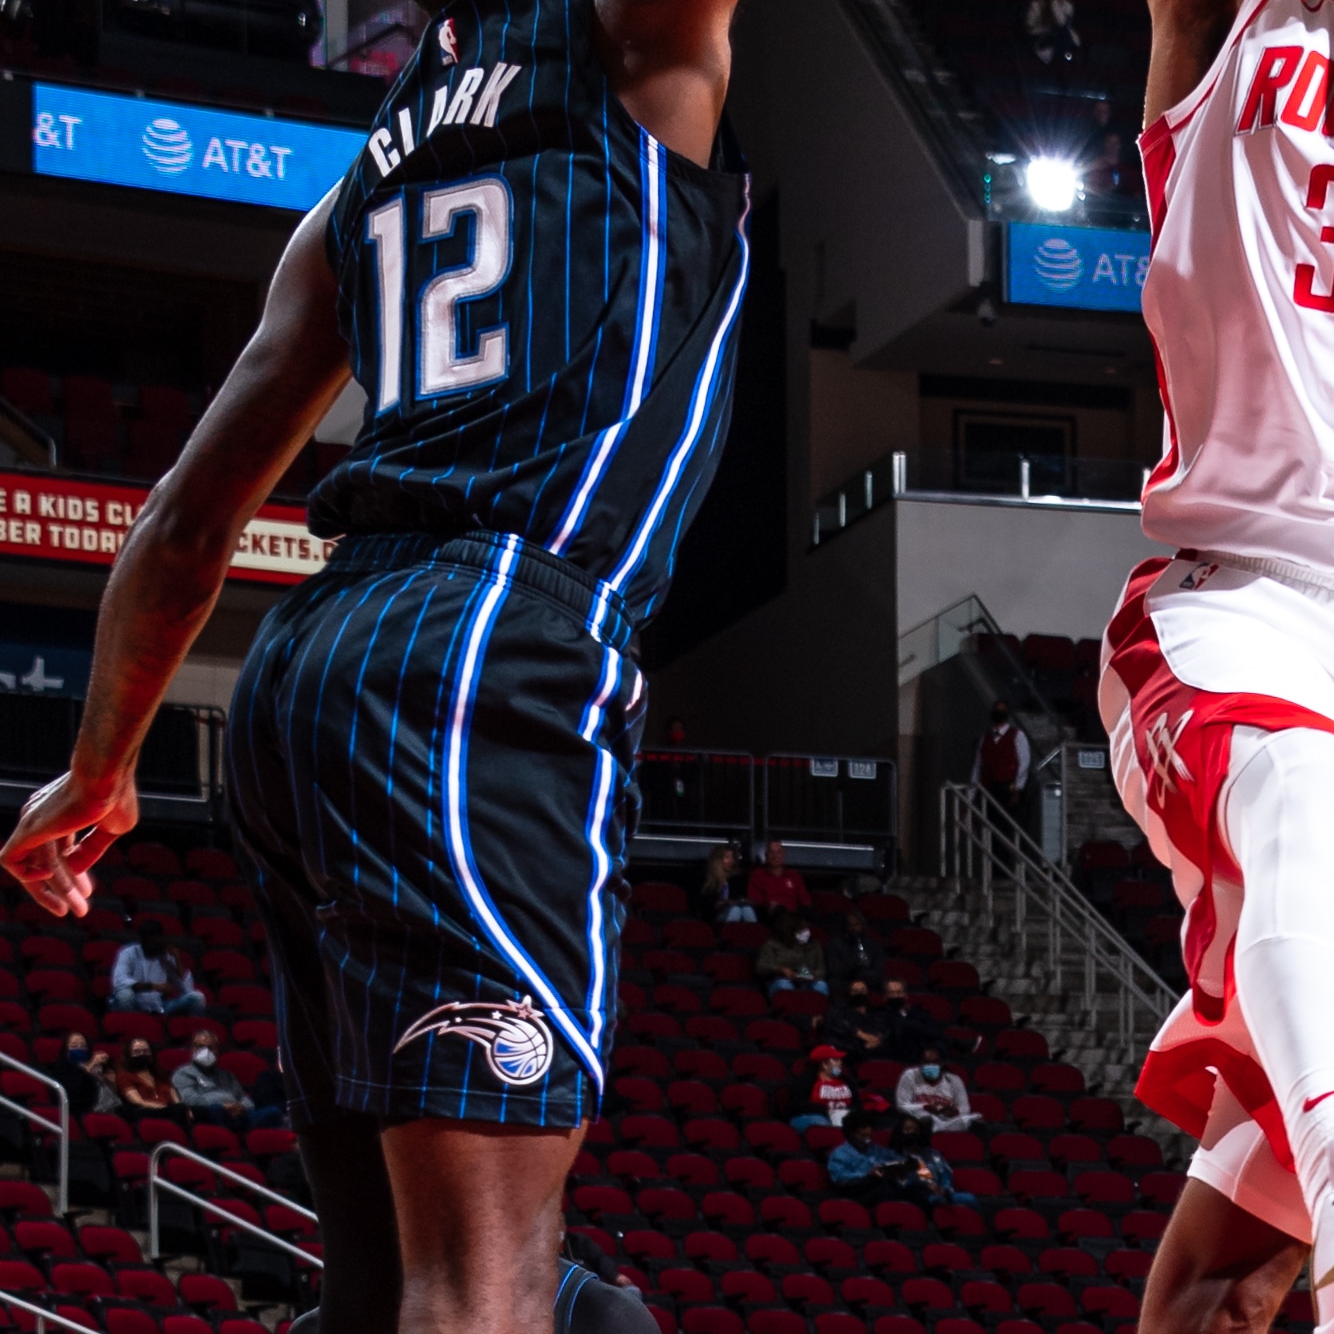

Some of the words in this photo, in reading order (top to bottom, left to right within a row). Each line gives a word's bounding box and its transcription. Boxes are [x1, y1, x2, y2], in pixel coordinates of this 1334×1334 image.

[201, 136, 293, 179] AT&T
[364, 174, 514, 420] 12
[38, 492, 100, 523] KIDS
[105, 500, 141, 527] CL
[47, 521, 125, 554] TODA
